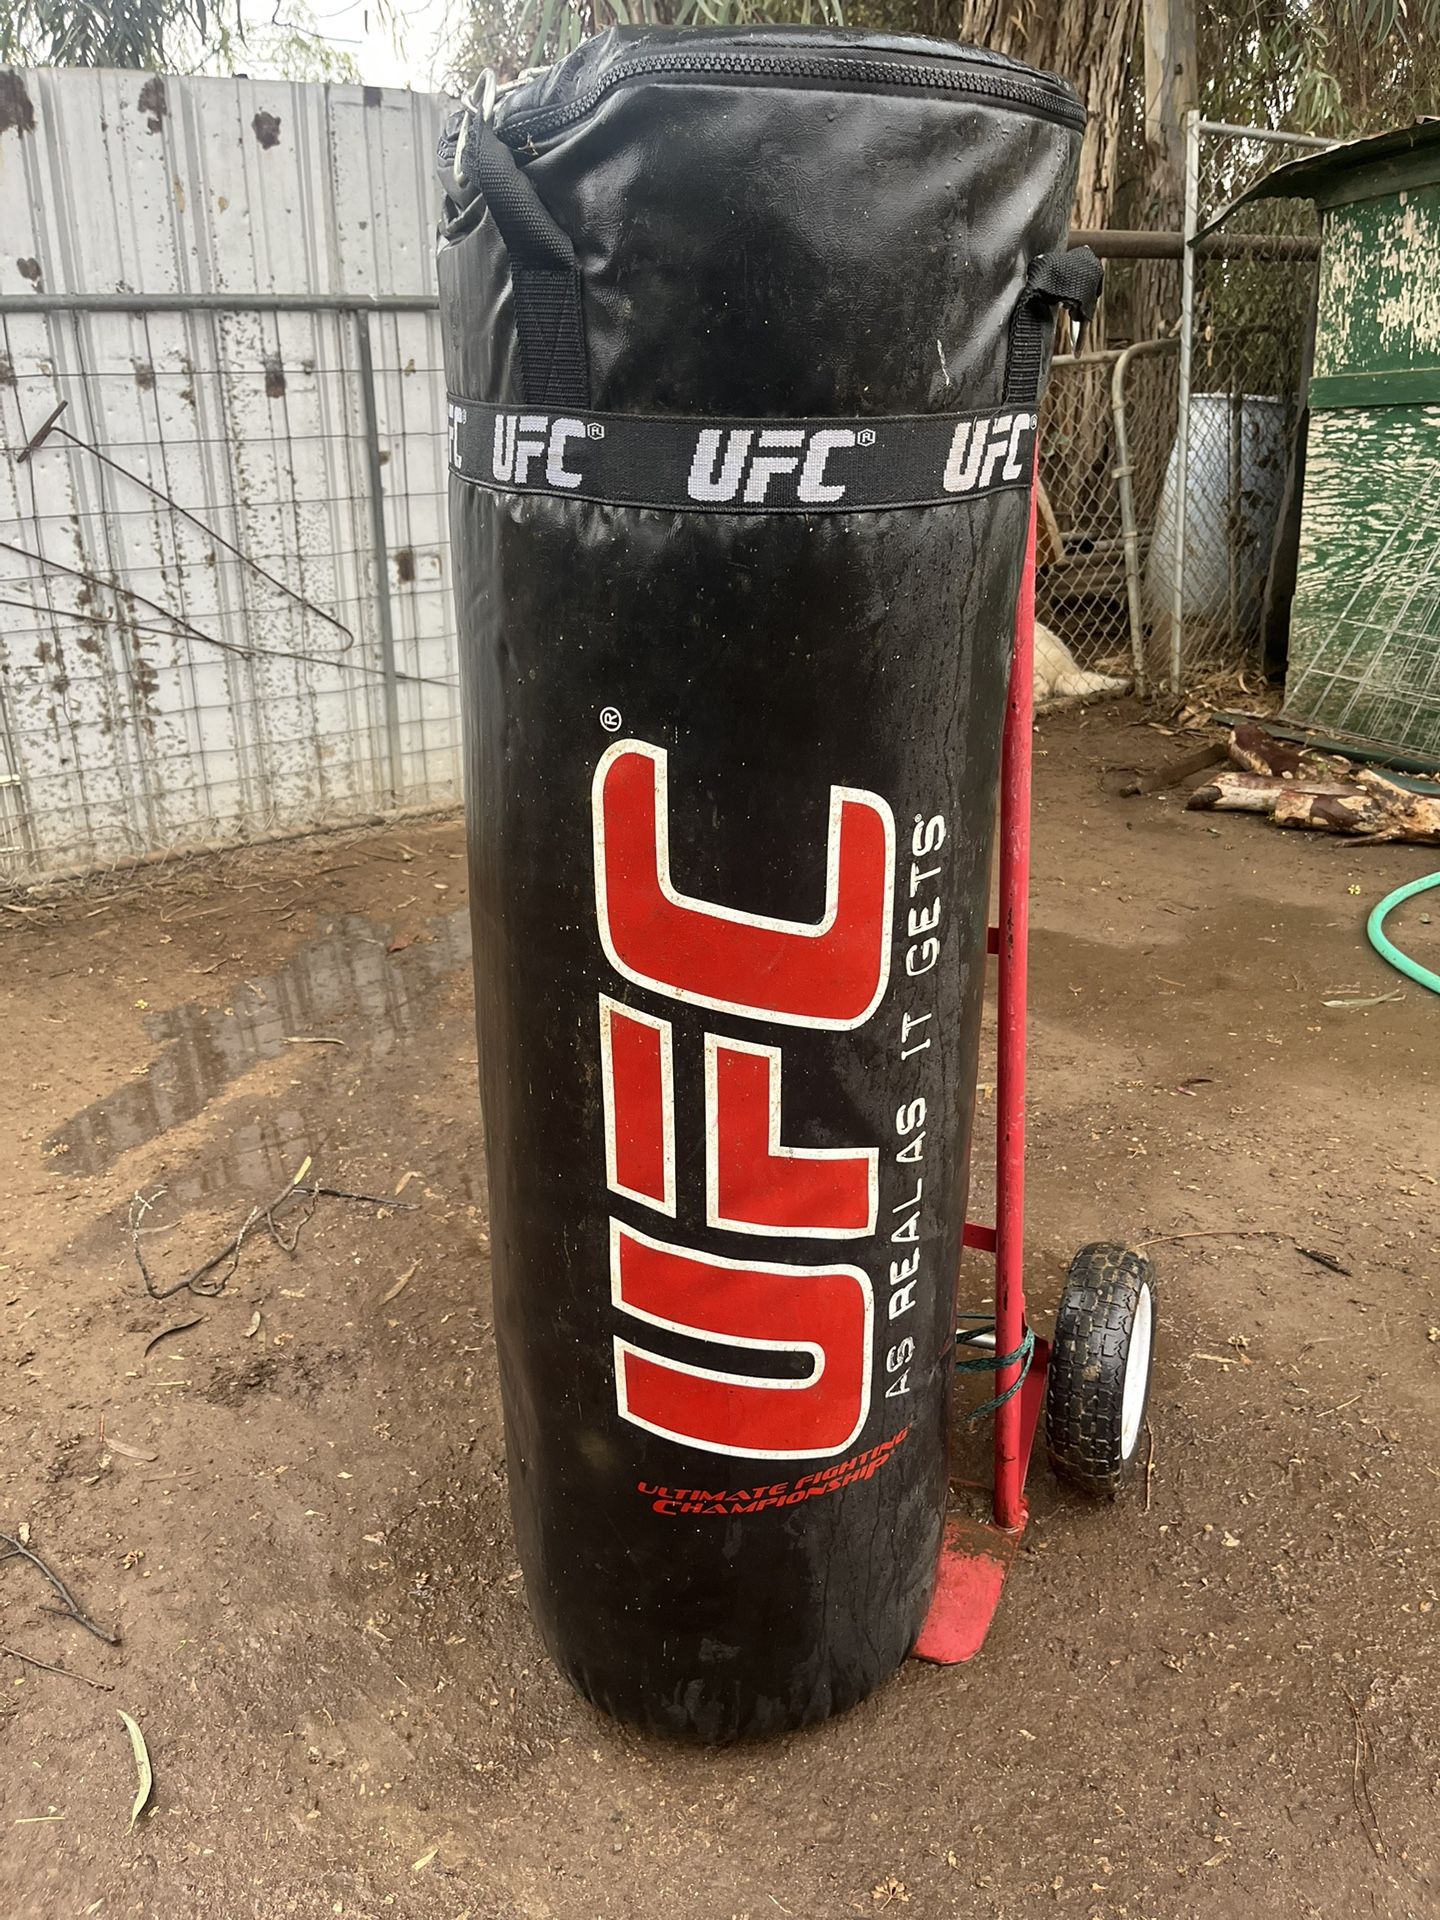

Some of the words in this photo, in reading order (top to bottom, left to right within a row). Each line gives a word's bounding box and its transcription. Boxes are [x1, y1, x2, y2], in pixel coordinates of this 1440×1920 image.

[901, 1012, 933, 1061] IT
[896, 1097, 927, 1163] AS
[888, 1177, 923, 1321] REAL
[885, 1335, 916, 1399] AS
[636, 1481, 789, 1501] ULTIMATE
[795, 1426, 909, 1488] FIGHTING
[652, 1452, 894, 1516] CHAMPIONSHIP
